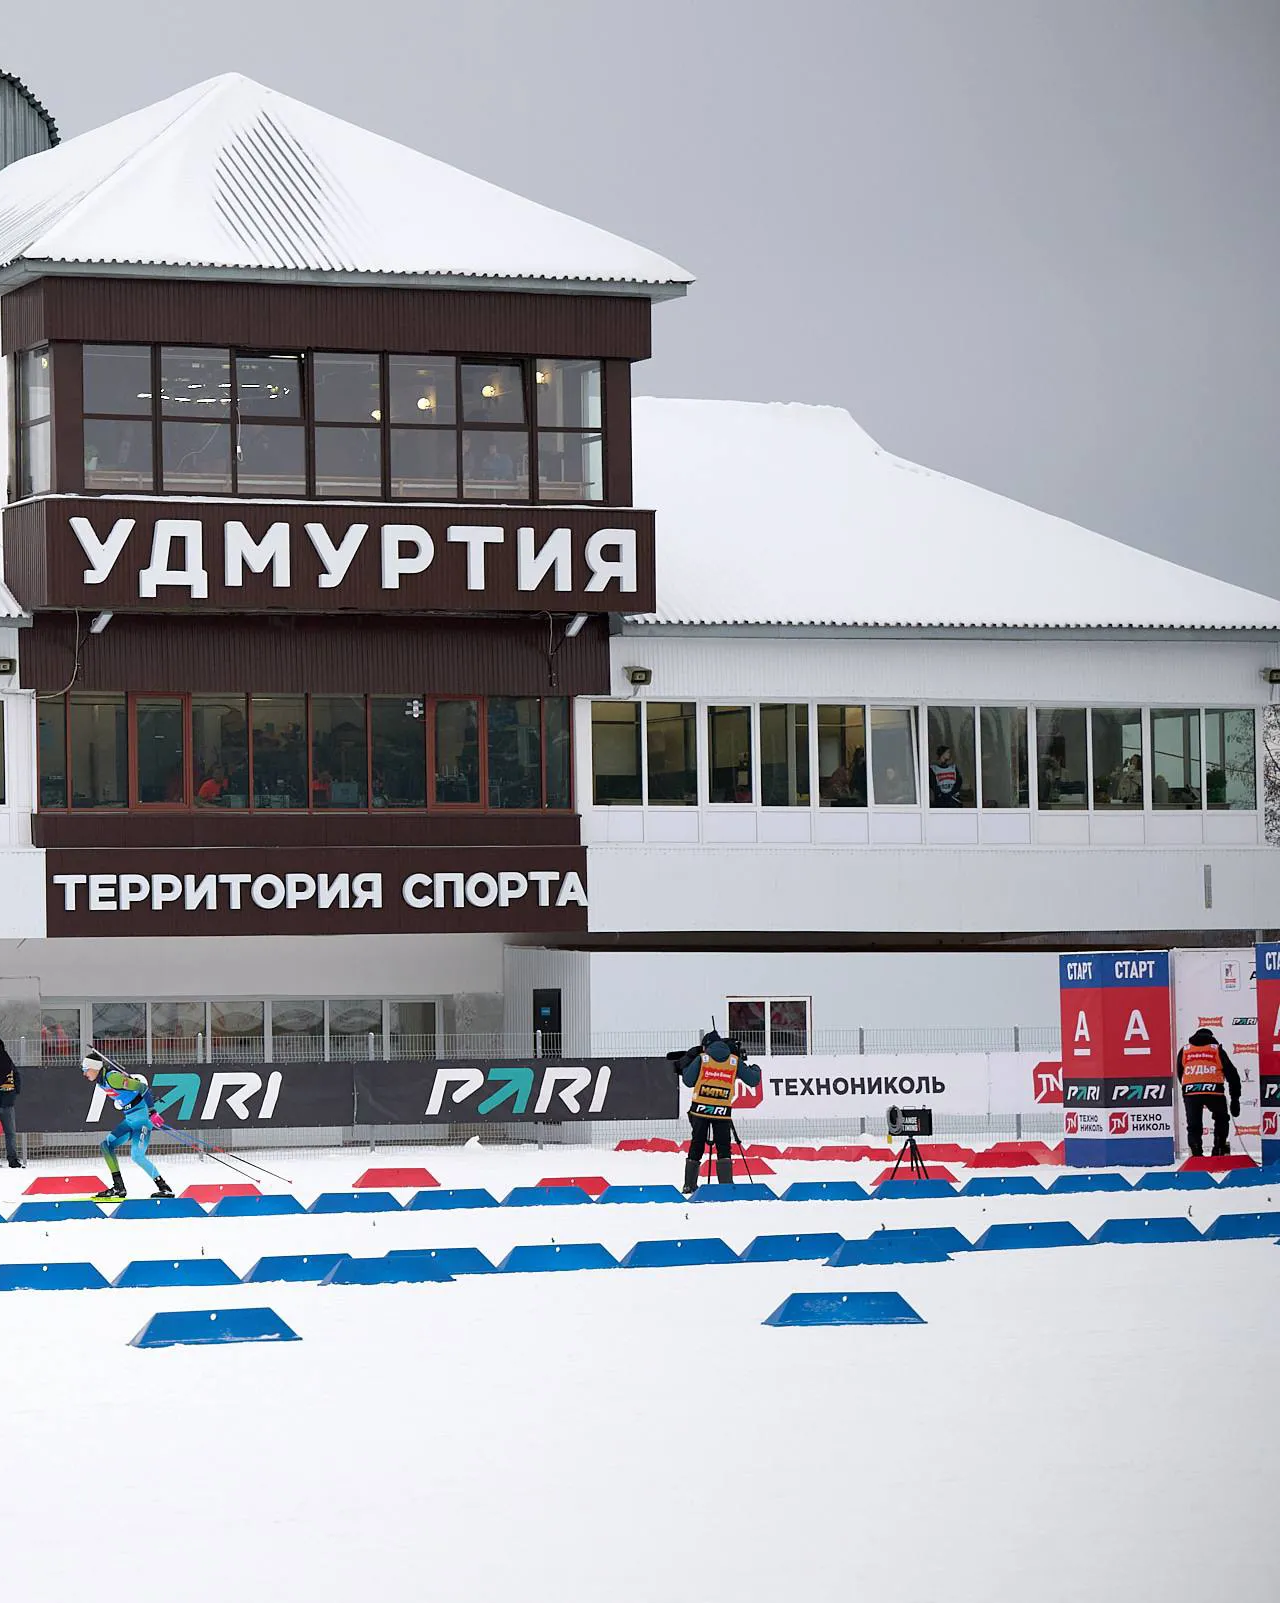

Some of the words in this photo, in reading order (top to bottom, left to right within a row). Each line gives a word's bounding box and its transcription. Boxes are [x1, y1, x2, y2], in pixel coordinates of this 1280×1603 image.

[68, 516, 638, 599] УДМУРТИЯ
[53, 872, 382, 912] ТЕРРИТОРИЯ
[403, 871, 588, 909] СПОРТА
[1067, 962, 1093, 980] СТАРТ
[1114, 961, 1155, 979] СТАРТ
[1185, 1065, 1217, 1075] СУДЬЯ
[424, 1066, 611, 1116] PARI
[770, 1075, 946, 1097] ТЕХНОНИКОЛЬ
[1066, 1085, 1100, 1101] PARI
[1112, 1084, 1166, 1100] PARI
[1185, 1083, 1217, 1093] PARI
[696, 1105, 728, 1116] PARI
[1080, 1114, 1099, 1123] ТЕХНО
[1131, 1113, 1162, 1122] ТЕХНО
[1081, 1123, 1104, 1132] НИКОЛЬ
[1132, 1122, 1171, 1132] НИКОЛЬ
